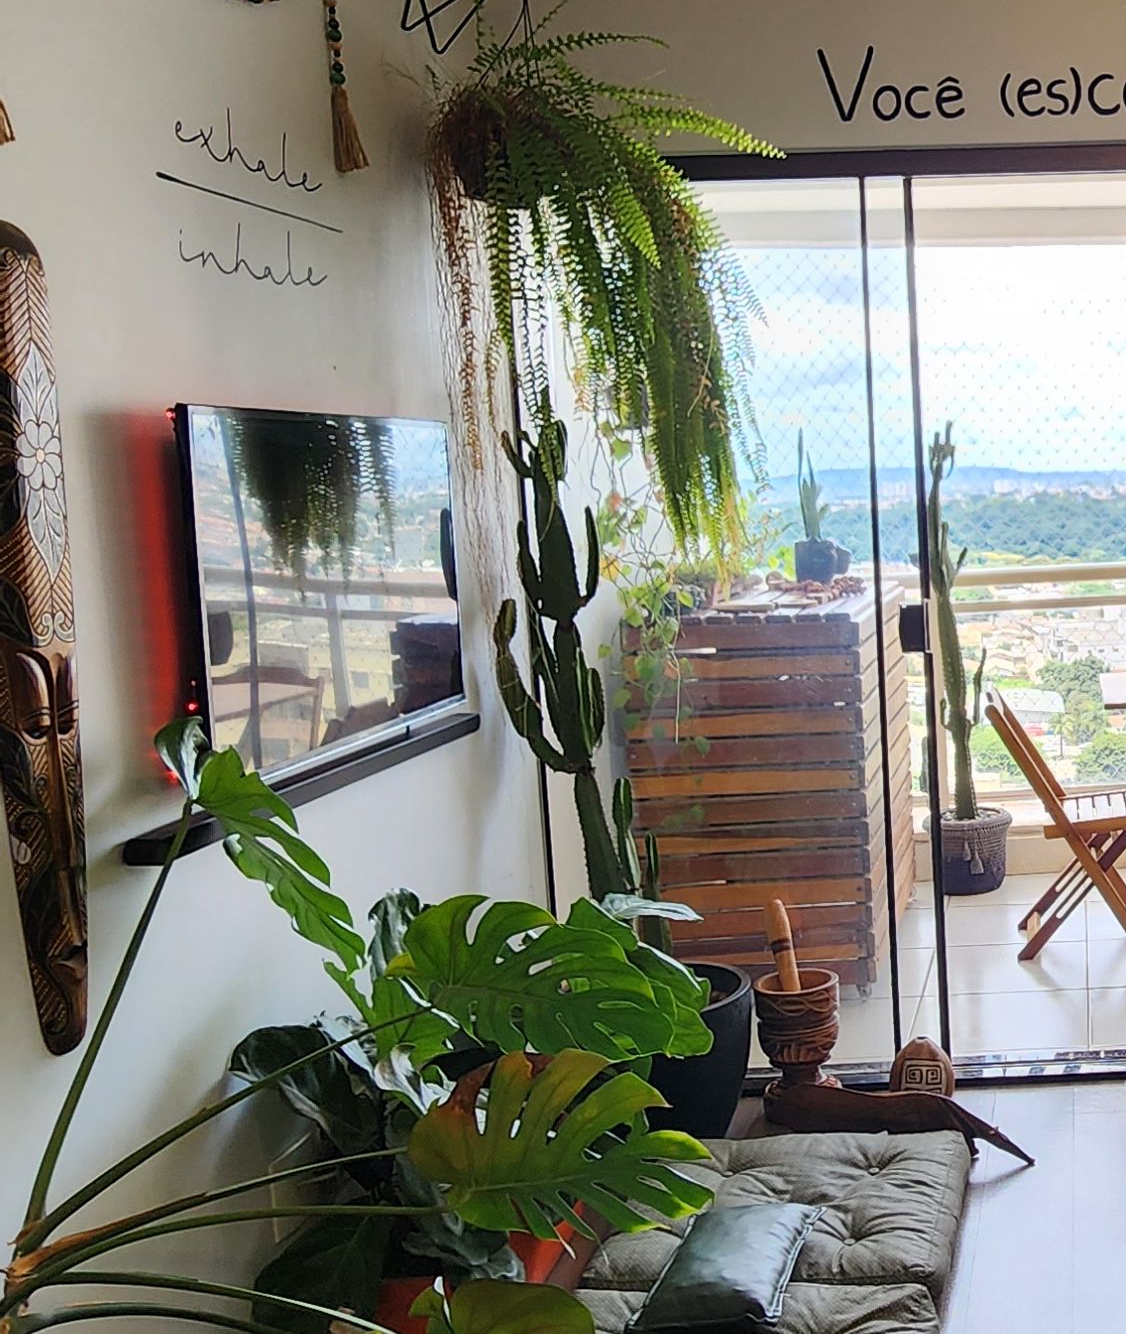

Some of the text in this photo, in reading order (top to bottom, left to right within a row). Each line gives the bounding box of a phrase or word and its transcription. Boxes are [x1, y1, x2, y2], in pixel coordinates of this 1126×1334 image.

[817, 45, 965, 122] Você
[175, 107, 323, 192] exhale
[179, 222, 328, 287] inhale
